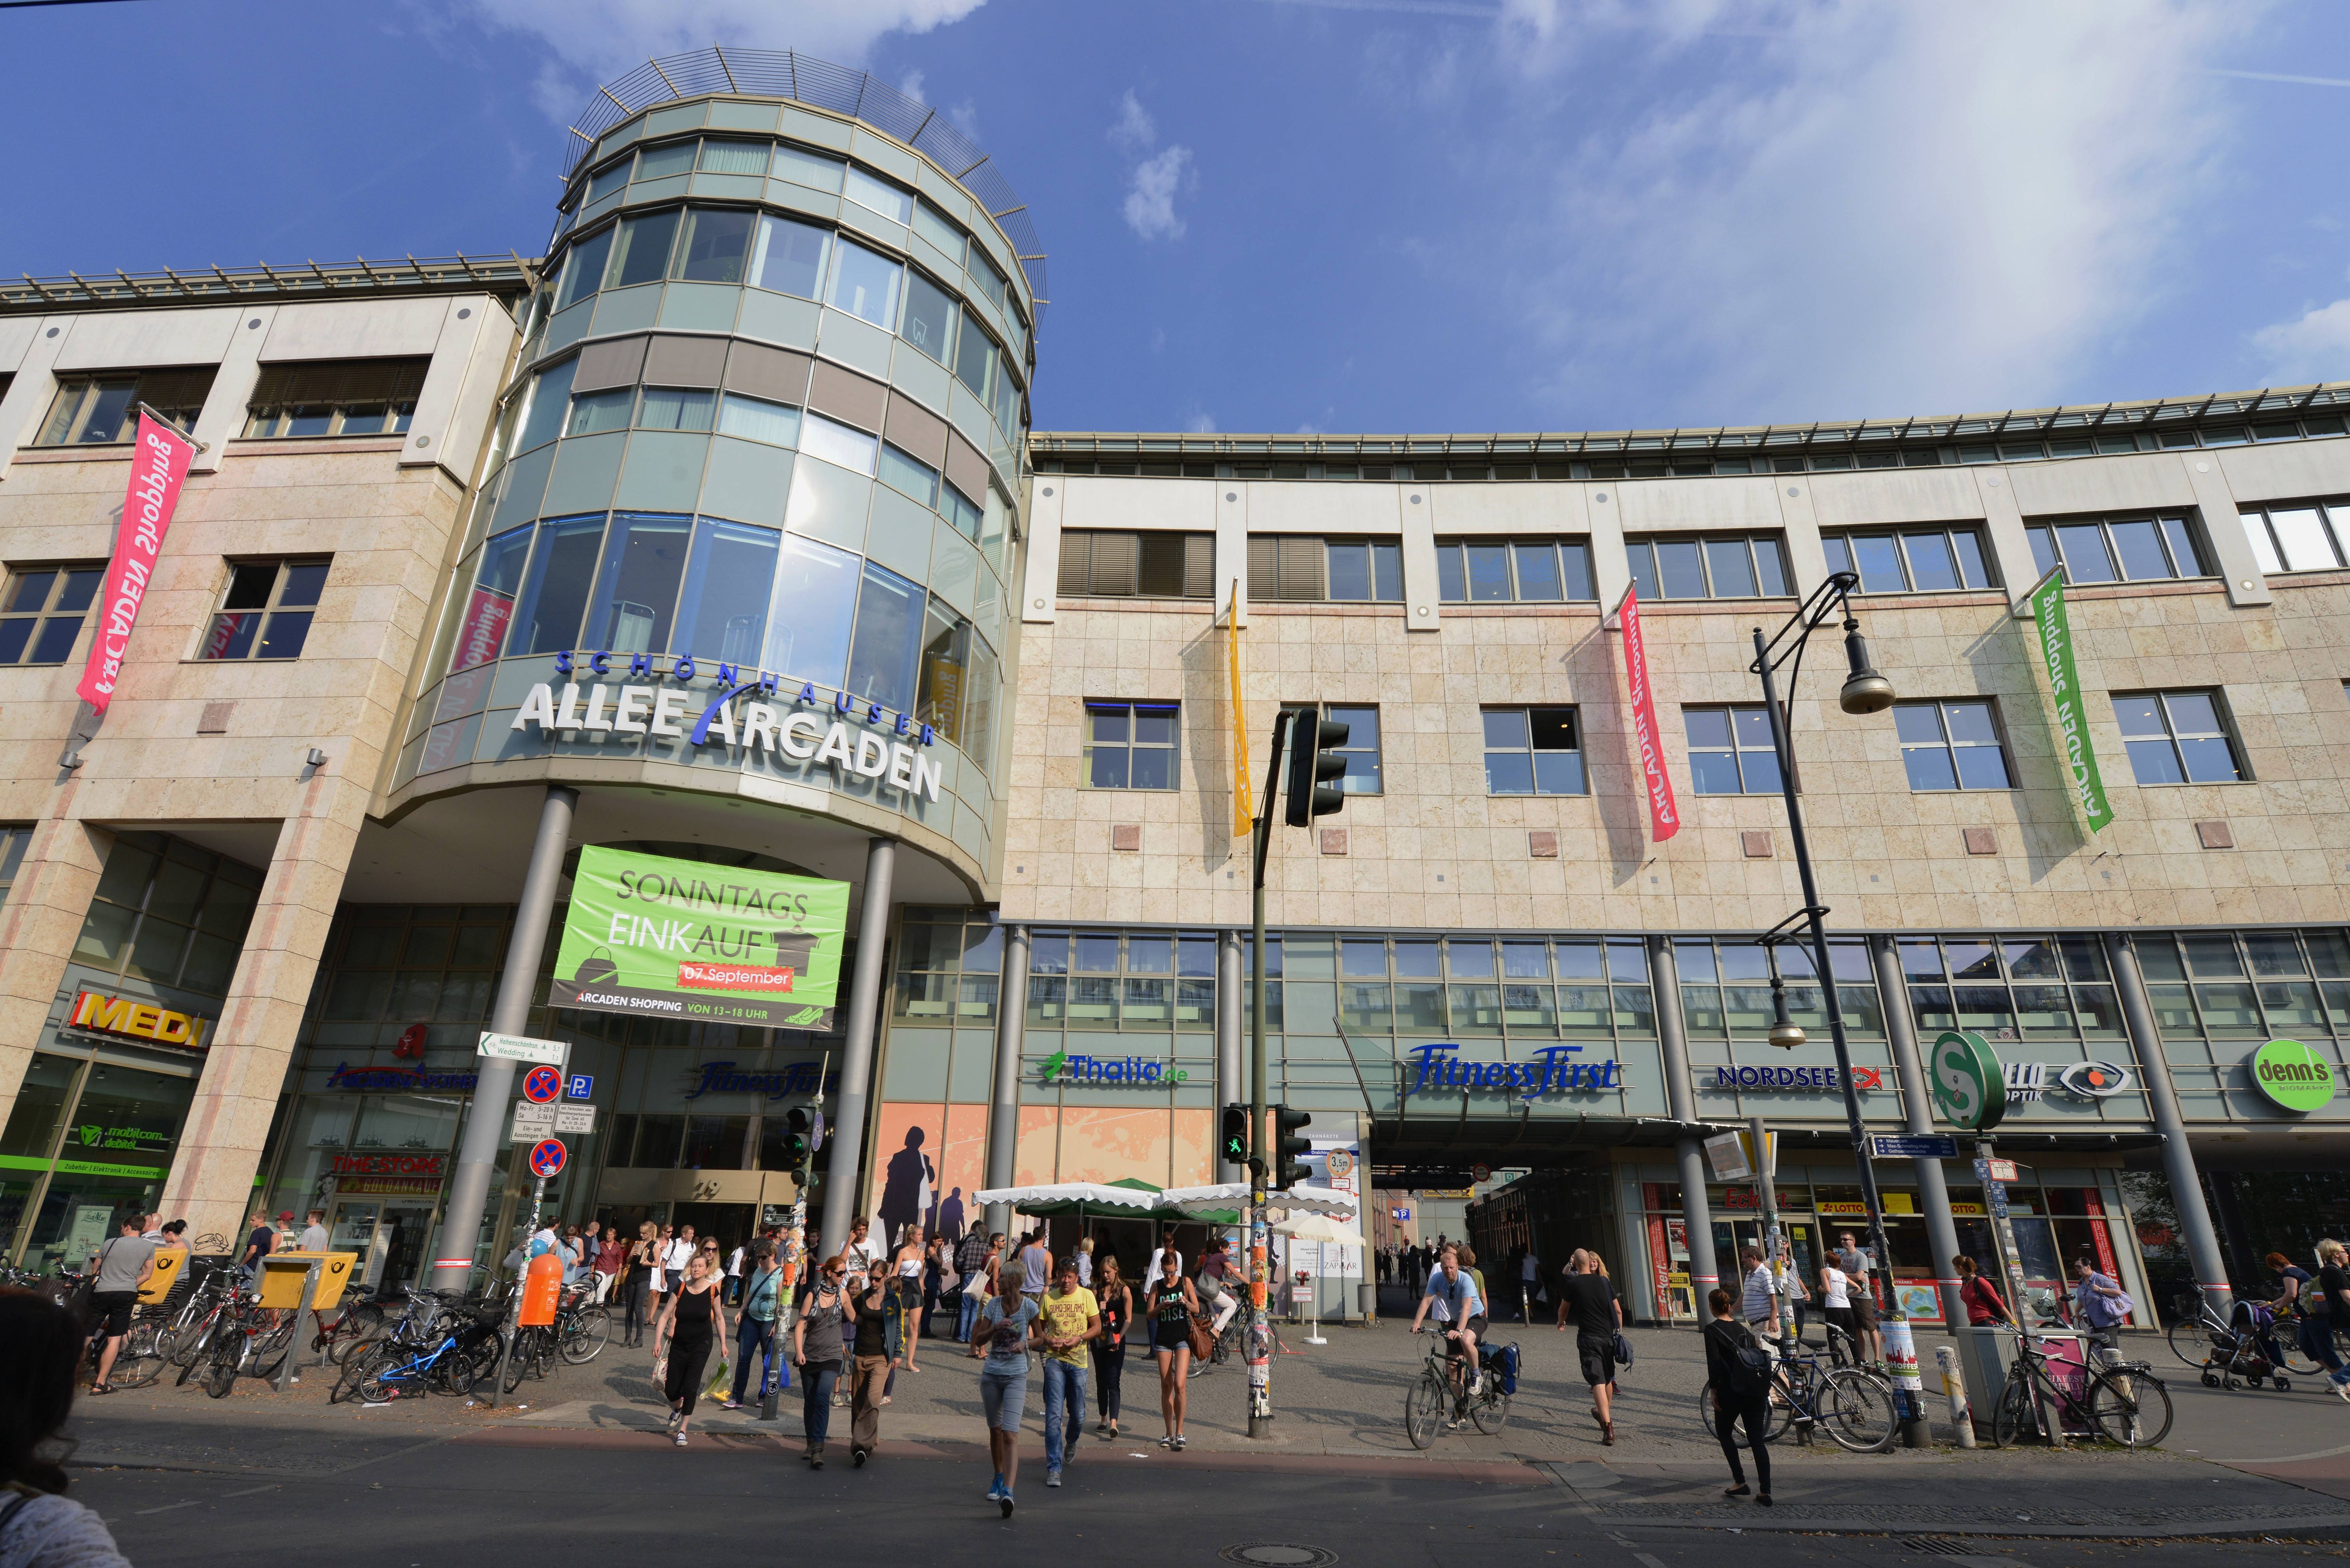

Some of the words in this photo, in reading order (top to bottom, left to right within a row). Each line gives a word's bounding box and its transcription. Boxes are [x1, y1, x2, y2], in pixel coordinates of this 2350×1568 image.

[1627, 605, 1643, 706] Shopping
[2042, 590, 2066, 696] Shopping
[555, 650, 935, 747] SCHÖNHAUSER
[510, 683, 689, 739] ALLEE
[691, 682, 942, 804] ARCADEN
[1637, 714, 1675, 823] ARCADEN
[2059, 703, 2102, 817] ARCADEN
[617, 870, 808, 921] SONNTAGS
[608, 913, 763, 959] EINKAUF
[684, 967, 788, 985] 07.September
[575, 990, 627, 1006] ARCADEN
[630, 997, 682, 1012] SHOPPING
[687, 1003, 710, 1015] VON
[746, 1008, 768, 1019] UHR
[72, 991, 205, 1046] MEDI
[498, 1048, 525, 1058] Wedding
[499, 1038, 539, 1049] Hohenschönhsn.
[684, 1062, 785, 1099] Fitness
[1397, 1044, 1535, 1096] Fitness
[1520, 1046, 1619, 1099] First
[1716, 1066, 1839, 1087] NORDSEE
[1936, 1041, 1979, 1122] S
[2000, 1062, 2046, 1088] LLO
[572, 1078, 586, 1095] P
[105, 1138, 136, 1149] debitel
[108, 1127, 162, 1140] mobilcom
[333, 1156, 374, 1172] TIME
[378, 1157, 441, 1173] STORE
[363, 1178, 439, 1192] GOLDANKAUF
[1725, 1188, 1792, 1209] Eckrt.
[1835, 1204, 1863, 1212] LOTTO
[1951, 1205, 1976, 1213] OTTO
[1161, 1308, 1184, 1322] DISE
